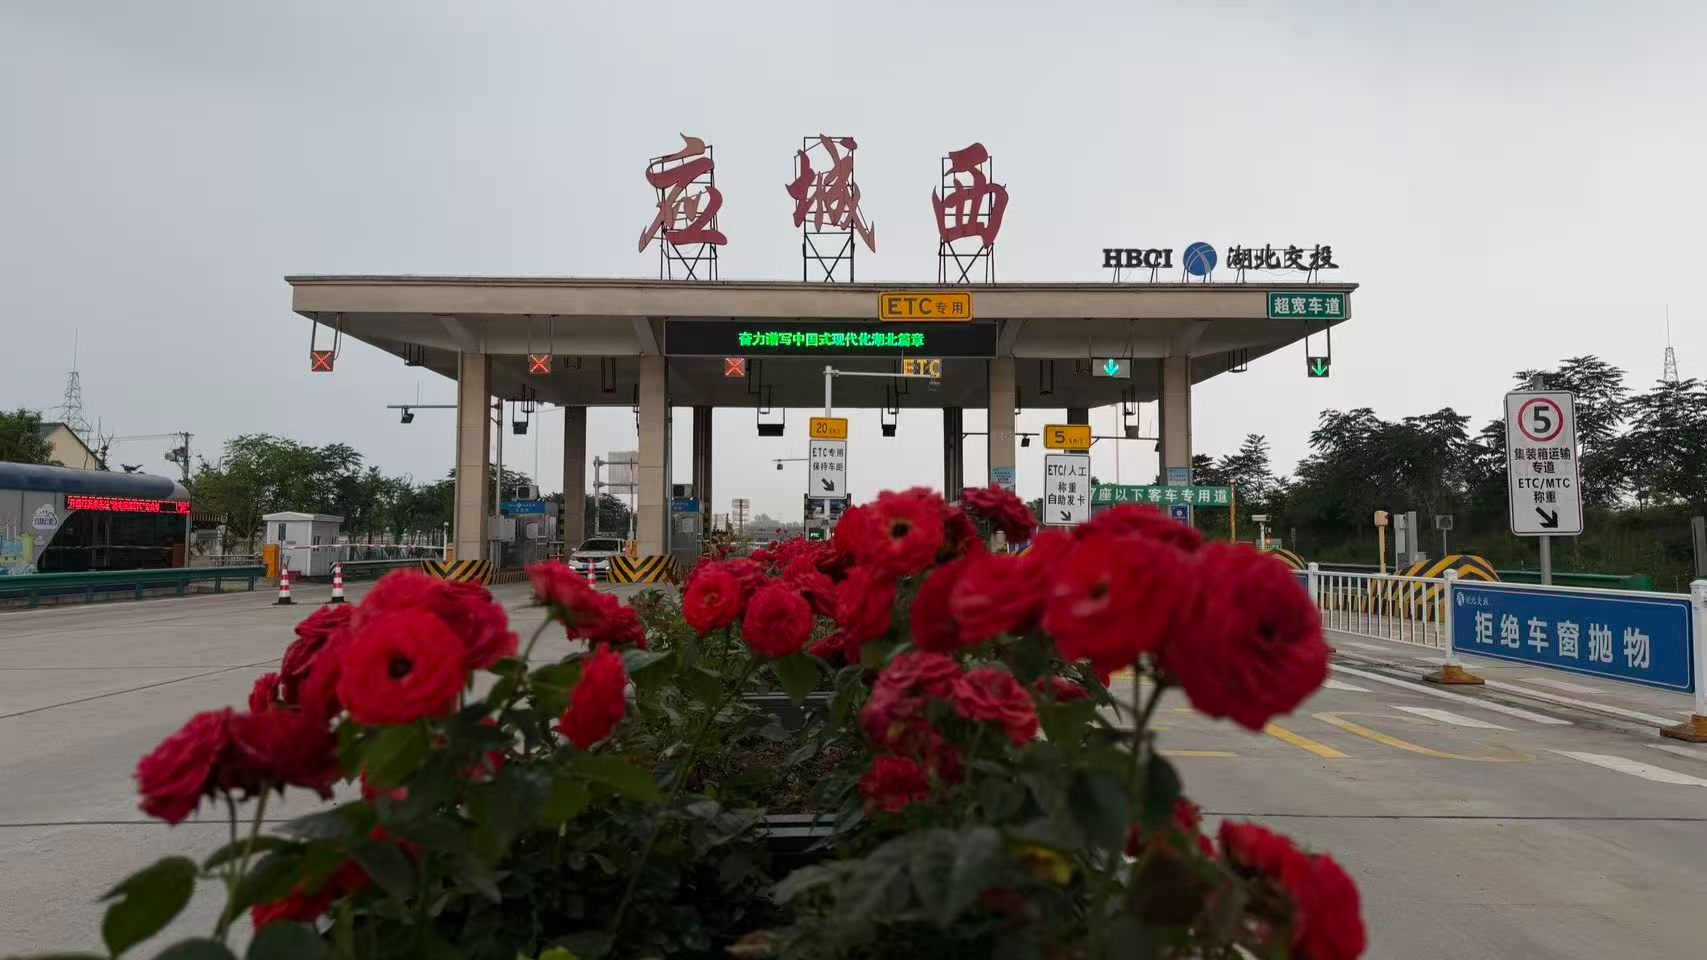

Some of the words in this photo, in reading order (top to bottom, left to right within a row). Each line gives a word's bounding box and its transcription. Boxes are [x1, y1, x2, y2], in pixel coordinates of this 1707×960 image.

[1102, 248, 1173, 268] HBCI
[1226, 244, 1340, 271] 湖北交投
[1274, 297, 1341, 315] 超宽车道
[738, 331, 925, 347] 奋力谱写中国式现代化湖北篇章
[903, 359, 941, 378] ETC
[1533, 406, 1551, 433] 5
[816, 422, 828, 434] 20
[1055, 431, 1065, 444] 5
[1514, 447, 1571, 461] 集装箱运输
[813, 462, 844, 472] 保持车距
[1532, 461, 1555, 474] 专道
[1058, 481, 1077, 493] 称重
[1518, 477, 1571, 489] ETC/MTC
[1048, 493, 1086, 506] 自助发卡
[1533, 490, 1556, 504] 称重
[1475, 610, 1650, 669] 拒绝车窗抛物
